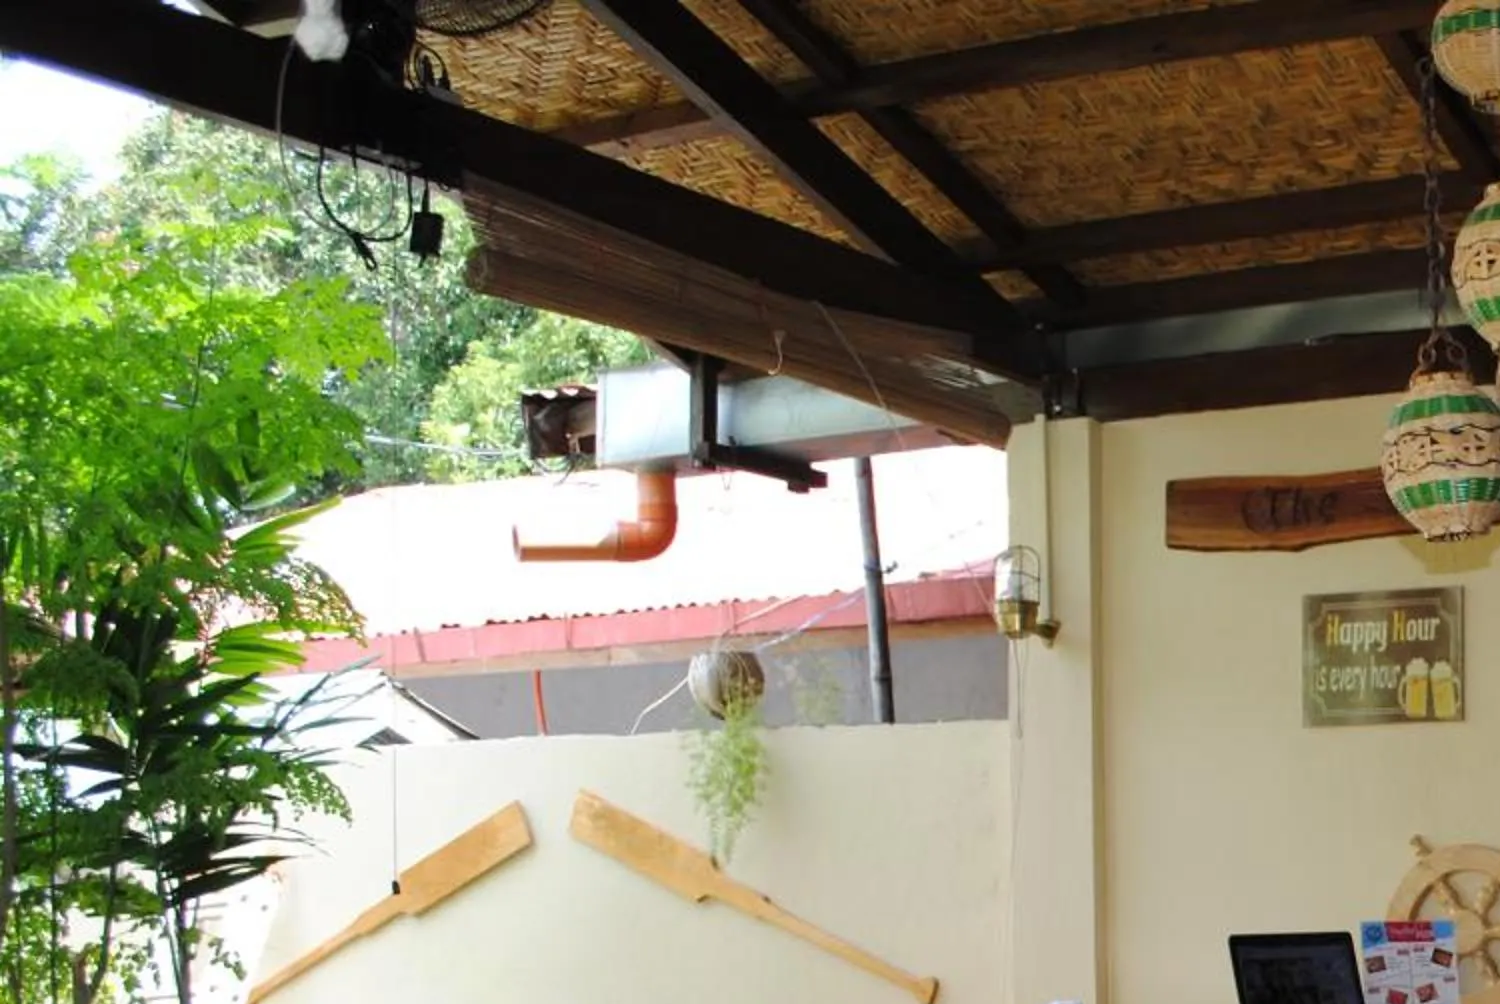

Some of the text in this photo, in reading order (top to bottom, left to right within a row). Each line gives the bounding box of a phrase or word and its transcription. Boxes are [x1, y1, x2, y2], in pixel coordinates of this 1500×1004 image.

[1325, 609, 1441, 654] Happy Hour
[1329, 664, 1366, 700] every
[1370, 655, 1402, 690] hour
